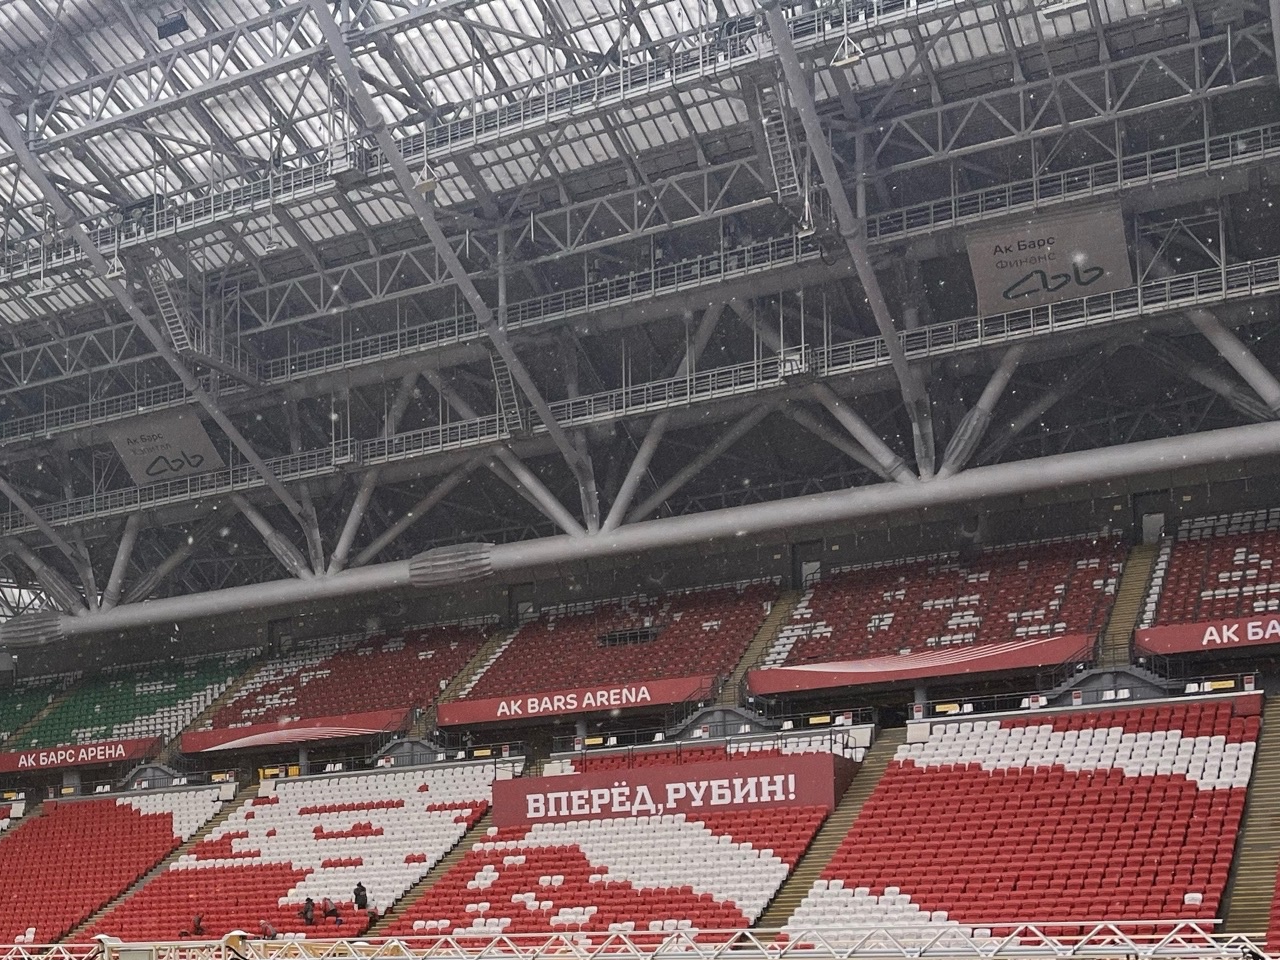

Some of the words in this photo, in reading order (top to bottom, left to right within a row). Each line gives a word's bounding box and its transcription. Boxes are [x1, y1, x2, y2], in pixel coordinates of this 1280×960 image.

[993, 245, 1013, 255] Ак
[1017, 237, 1055, 251] Барс
[1202, 624, 1240, 645] АК
[496, 699, 522, 717] AK
[527, 693, 578, 714] BARS
[582, 686, 651, 708] ARENA
[18, 753, 36, 768] АК
[39, 749, 75, 766] БАРС
[78, 744, 126, 762] АРЕНА
[526, 781, 664, 819] ВПЕРЁД,
[665, 774, 796, 809] РУБИН!
